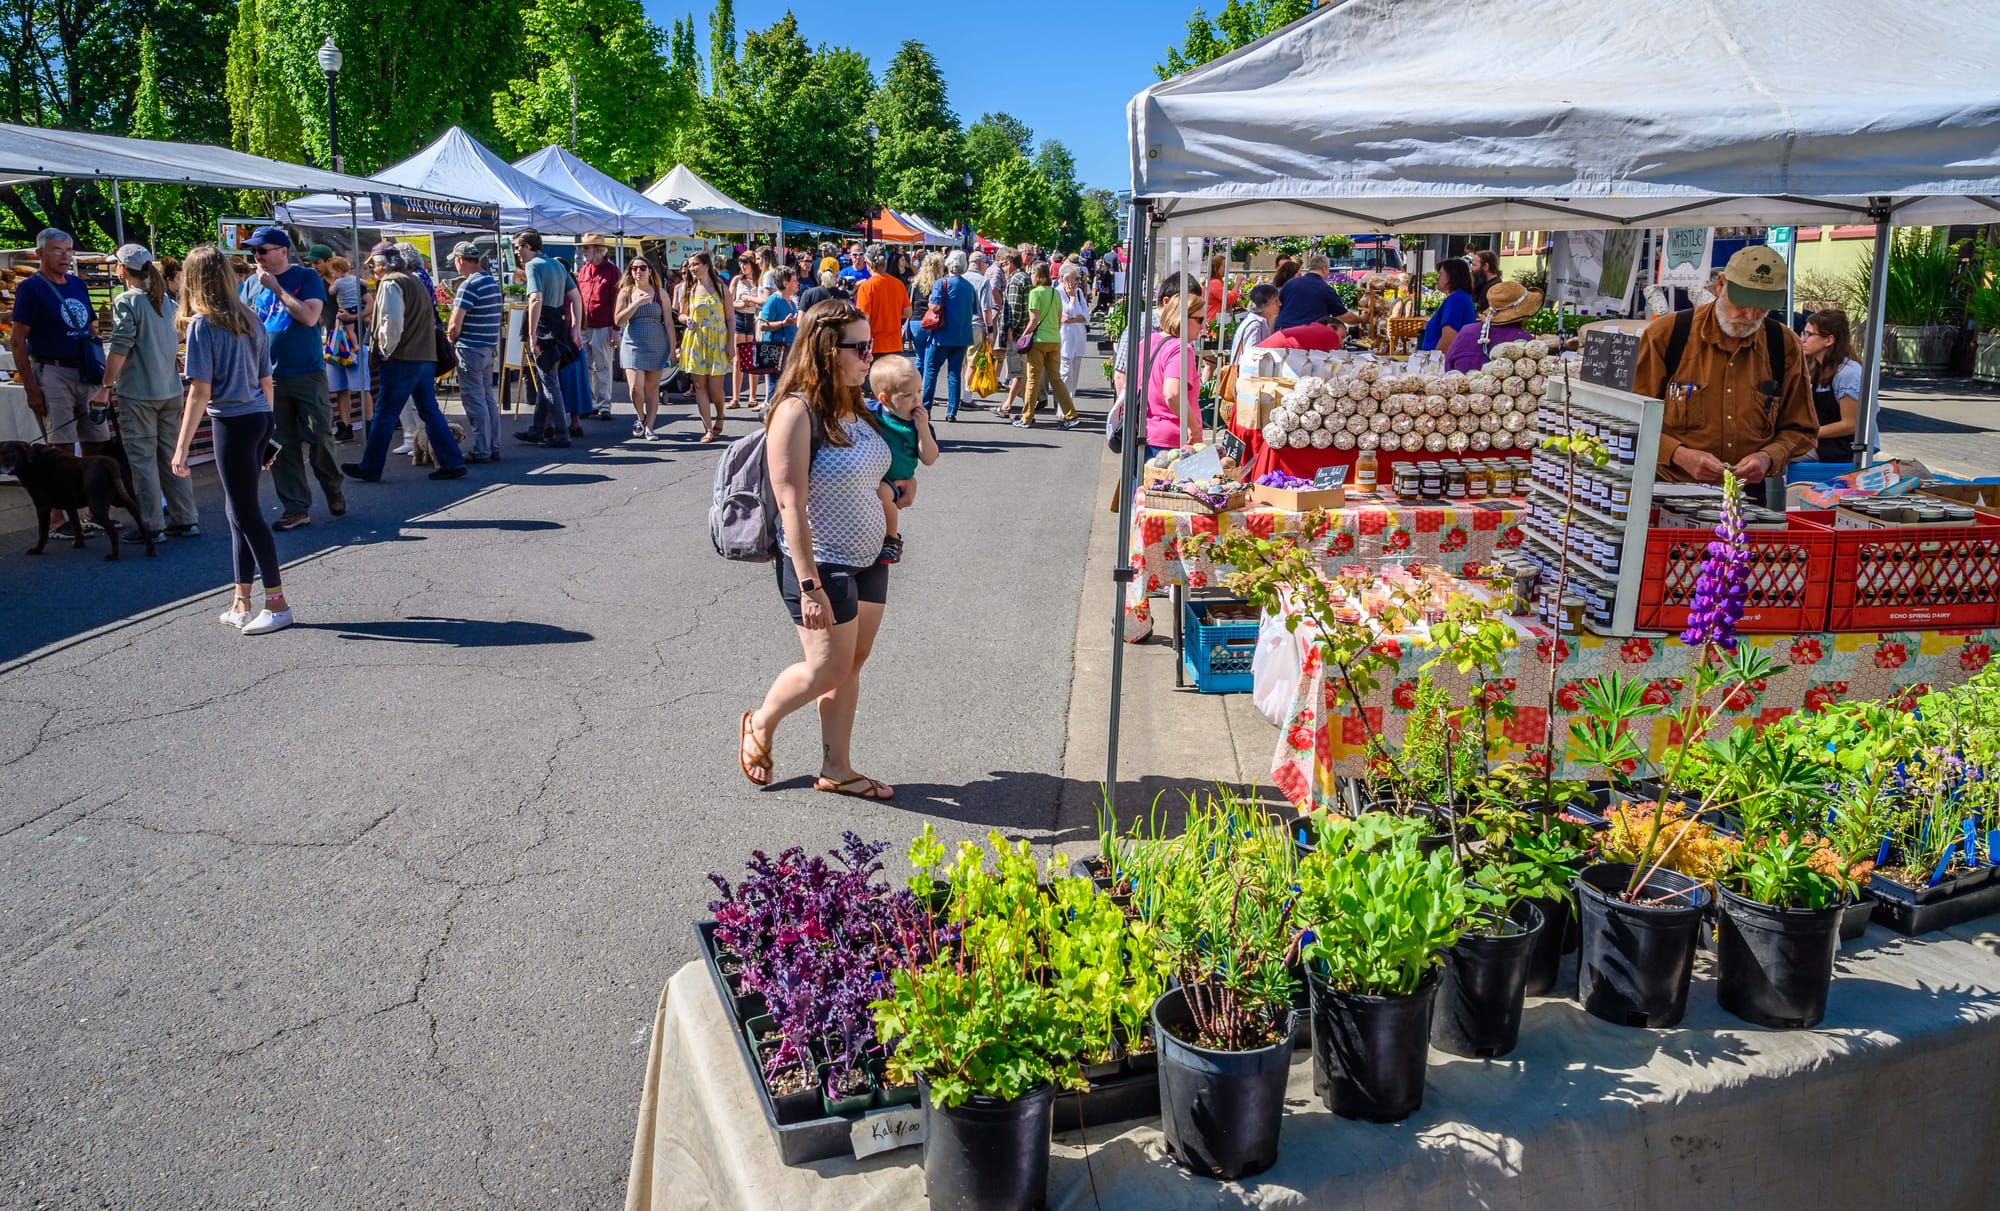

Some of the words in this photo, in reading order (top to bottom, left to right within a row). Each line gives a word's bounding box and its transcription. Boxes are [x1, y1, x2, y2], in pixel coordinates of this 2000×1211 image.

[402, 197, 425, 213] THE
[424, 199, 452, 216] BREAD
[453, 203, 482, 219] BOARD
[1679, 249, 1693, 258] FARM
